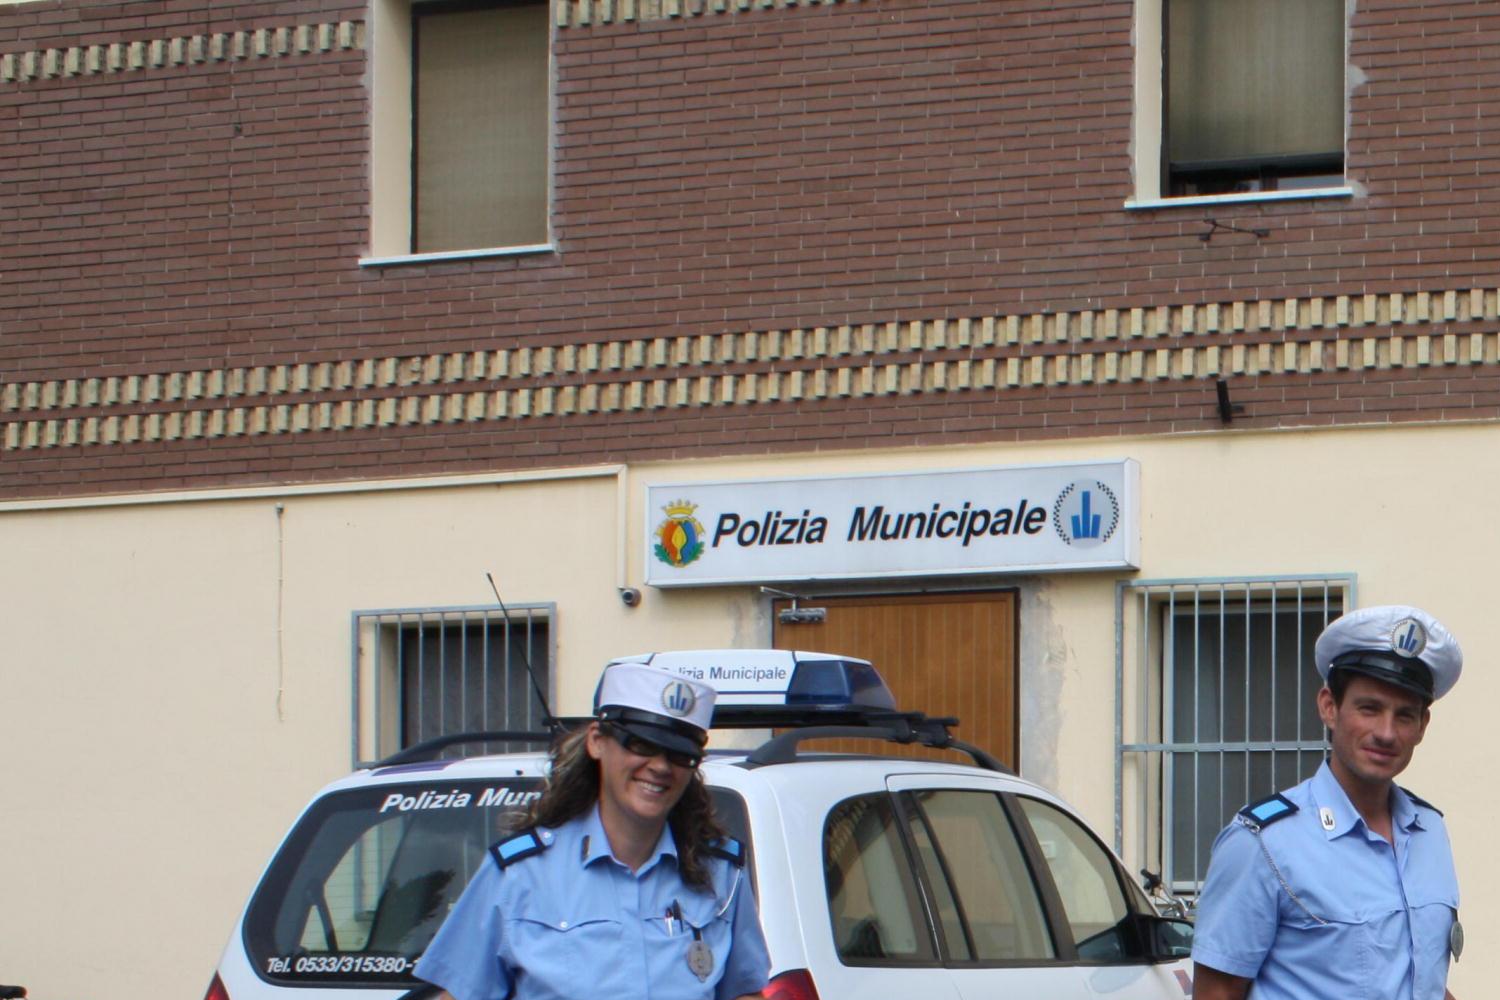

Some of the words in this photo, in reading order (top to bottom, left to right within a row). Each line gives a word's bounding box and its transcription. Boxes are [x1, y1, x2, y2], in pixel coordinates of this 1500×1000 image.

[712, 508, 828, 548] Polizia
[847, 499, 1047, 547] Municipale
[709, 666, 787, 682] Municipale
[379, 789, 472, 813] Polizia
[477, 787, 543, 807] Mun
[266, 957, 291, 973] Tel.
